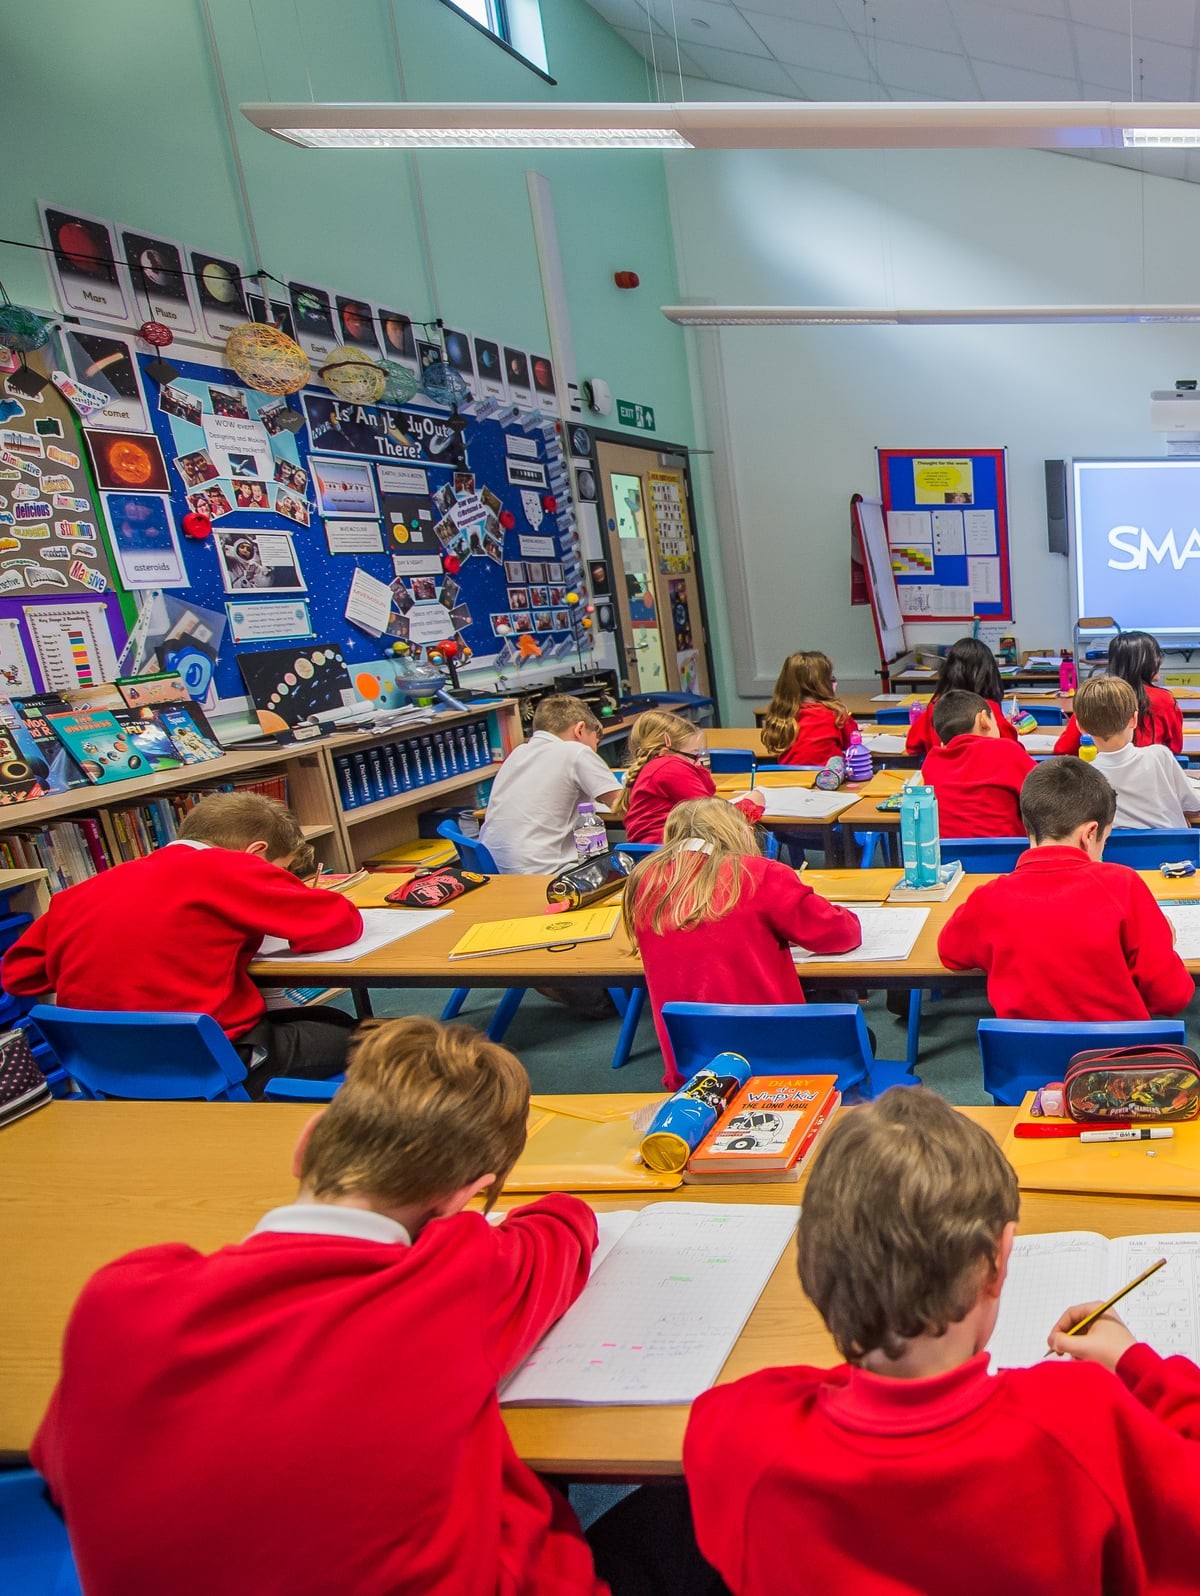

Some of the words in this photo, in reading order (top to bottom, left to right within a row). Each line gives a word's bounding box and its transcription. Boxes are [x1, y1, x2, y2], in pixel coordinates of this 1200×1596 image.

[83, 290, 107, 305] Mars
[155, 306, 178, 319] Pluto
[102, 408, 131, 420] comet
[214, 419, 236, 429] WOW
[332, 401, 351, 423] Is
[620, 405, 635, 419] EXIT
[374, 436, 423, 459] There?
[15, 502, 51, 519] delicious
[60, 521, 94, 540] stunning
[70, 560, 105, 590] Massive
[134, 562, 170, 572] asteroids
[167, 716, 186, 726] Space
[439, 743, 447, 774] Dictionary
[449, 740, 457, 770] Dictionary
[460, 737, 469, 766] Dictionary
[471, 734, 480, 763] Dictionary
[481, 731, 490, 760] Dictionary
[388, 756, 398, 789] Dictionary
[401, 753, 411, 785] Dictionary
[414, 749, 424, 781] Dictionary
[427, 746, 436, 777] Dictionary
[344, 768, 355, 802] Dictionary
[359, 764, 370, 797] Dictionary
[374, 760, 384, 793] Dictionary
[747, 1091, 792, 1104] Wimpy
[791, 1090, 819, 1102] Kid
